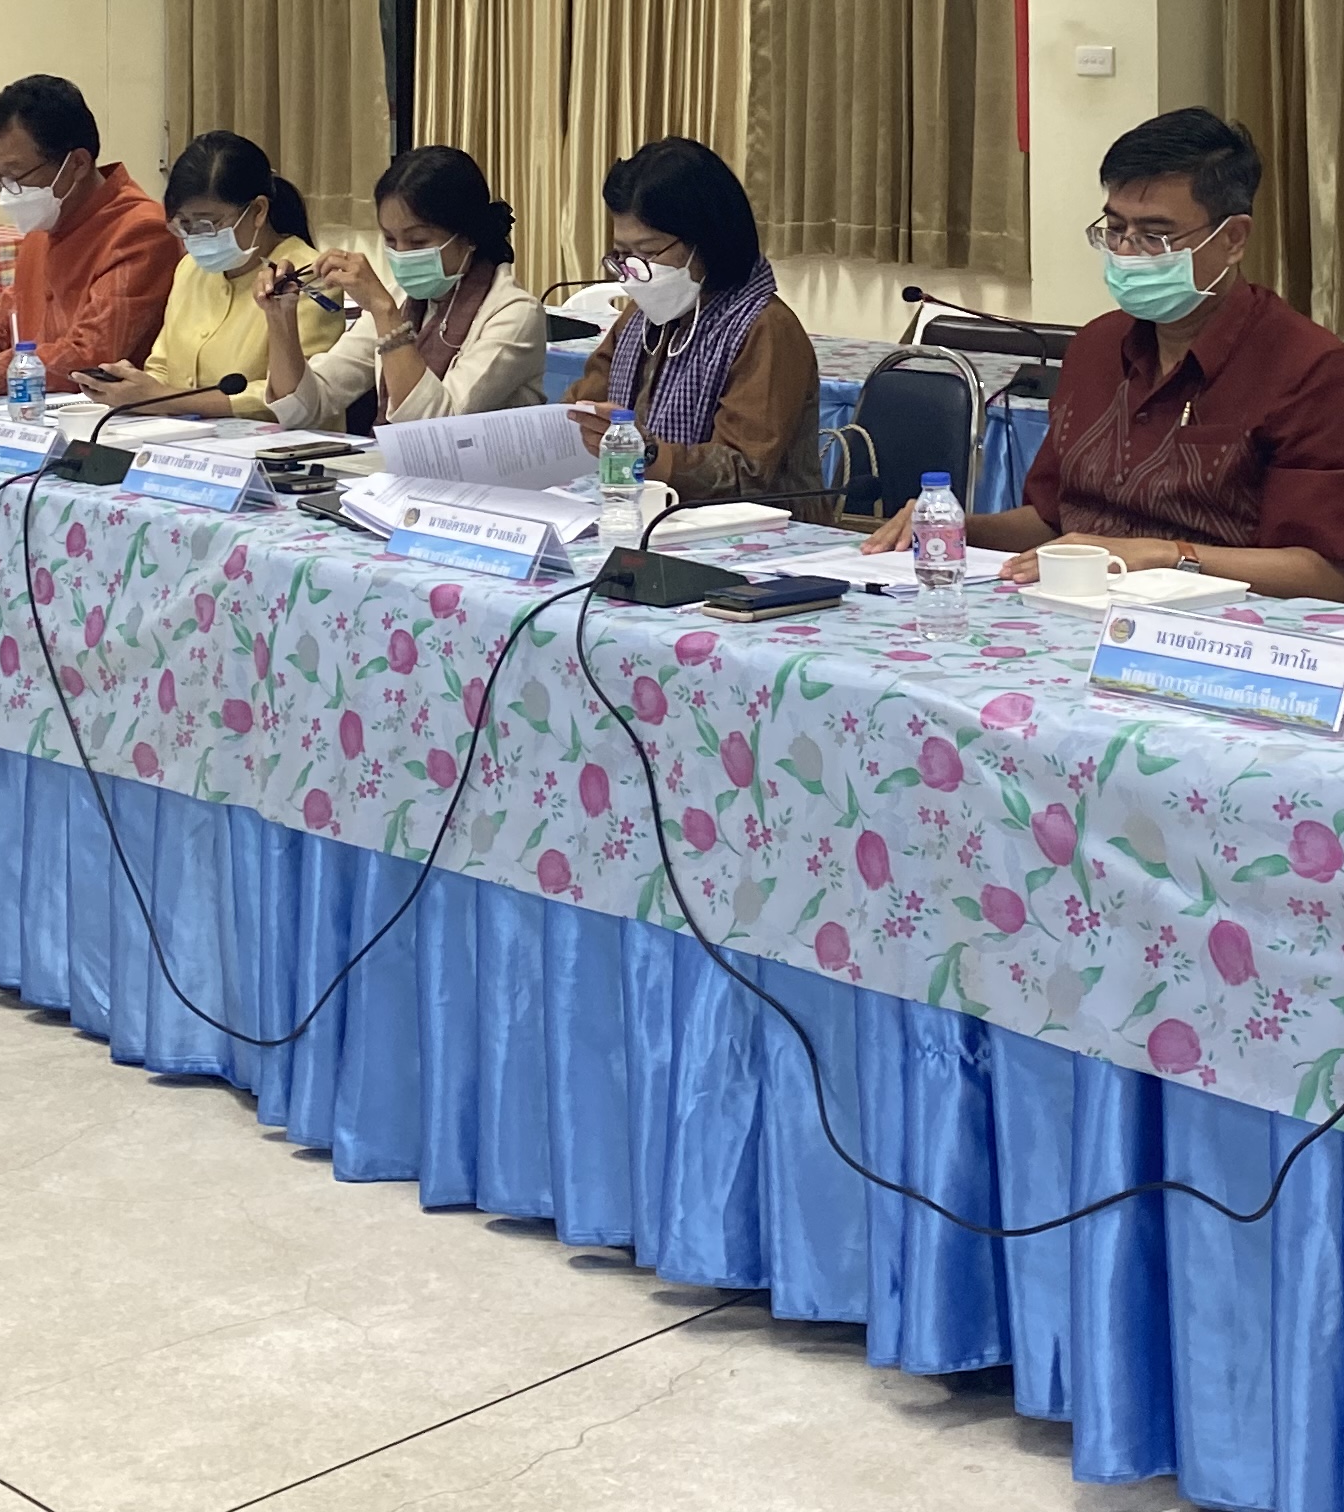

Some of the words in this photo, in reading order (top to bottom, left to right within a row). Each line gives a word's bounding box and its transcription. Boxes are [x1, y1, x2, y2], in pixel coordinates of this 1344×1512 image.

[1156, 630, 1254, 660] นายจักรวรรดิ
